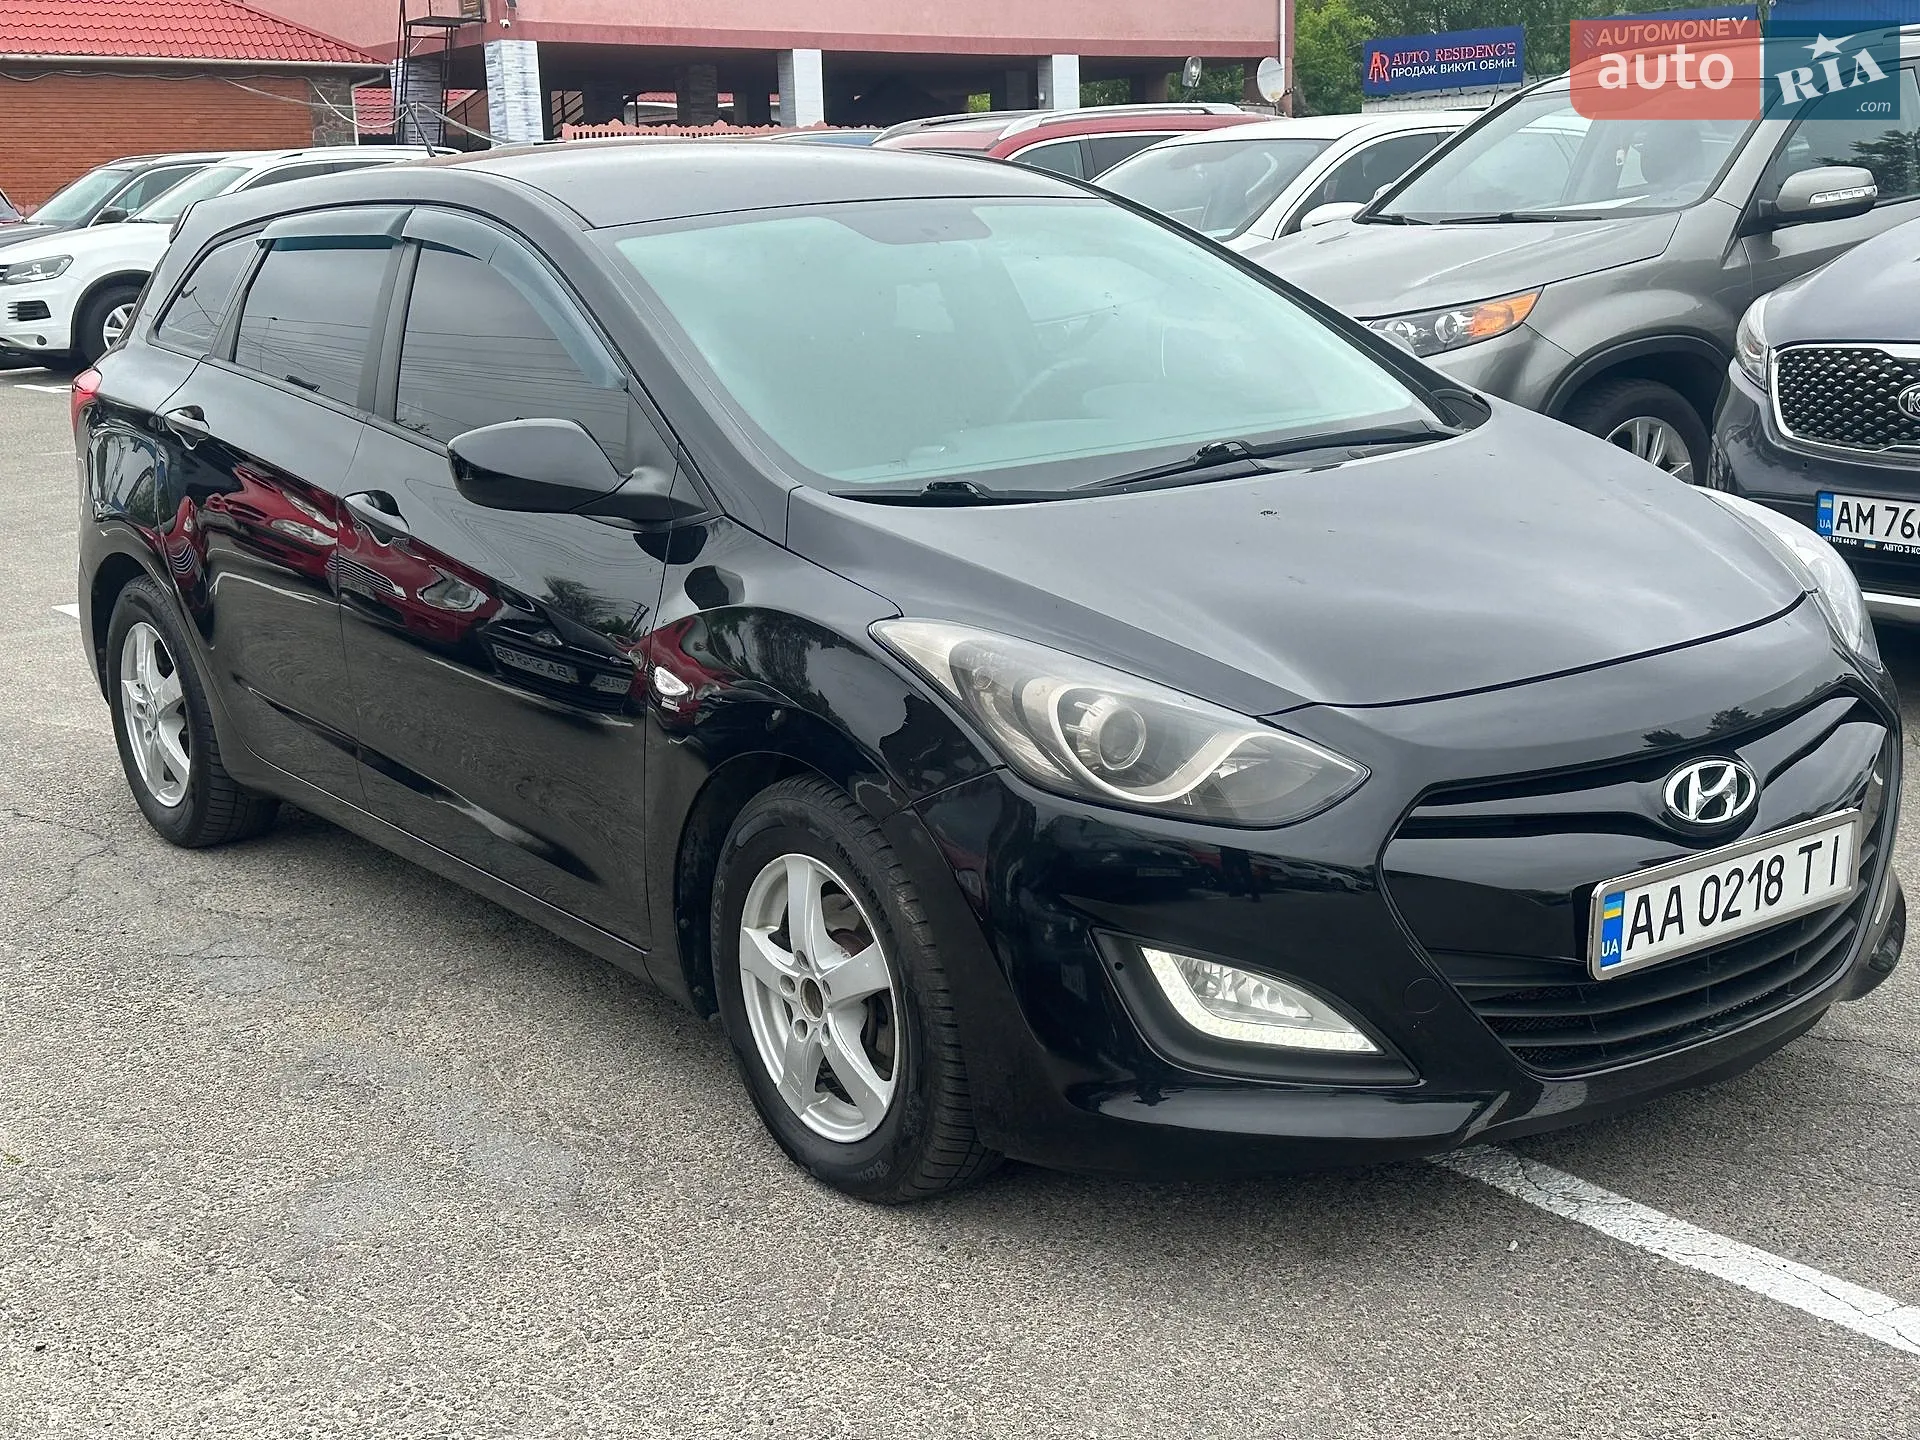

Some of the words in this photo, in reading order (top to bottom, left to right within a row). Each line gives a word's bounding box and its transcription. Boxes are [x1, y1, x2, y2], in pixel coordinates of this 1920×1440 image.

[1596, 16, 1749, 47] AUTOMONEY
[1392, 50, 1430, 66] AUTO
[1435, 42, 1517, 62] RESIDENCE
[1819, 519, 1832, 530] UA
[1835, 500, 1876, 536] AM
[1625, 884, 1685, 951] AA
[1699, 854, 1785, 927] 0218
[1798, 835, 1840, 896] TI
[1601, 939, 1619, 958] UA
